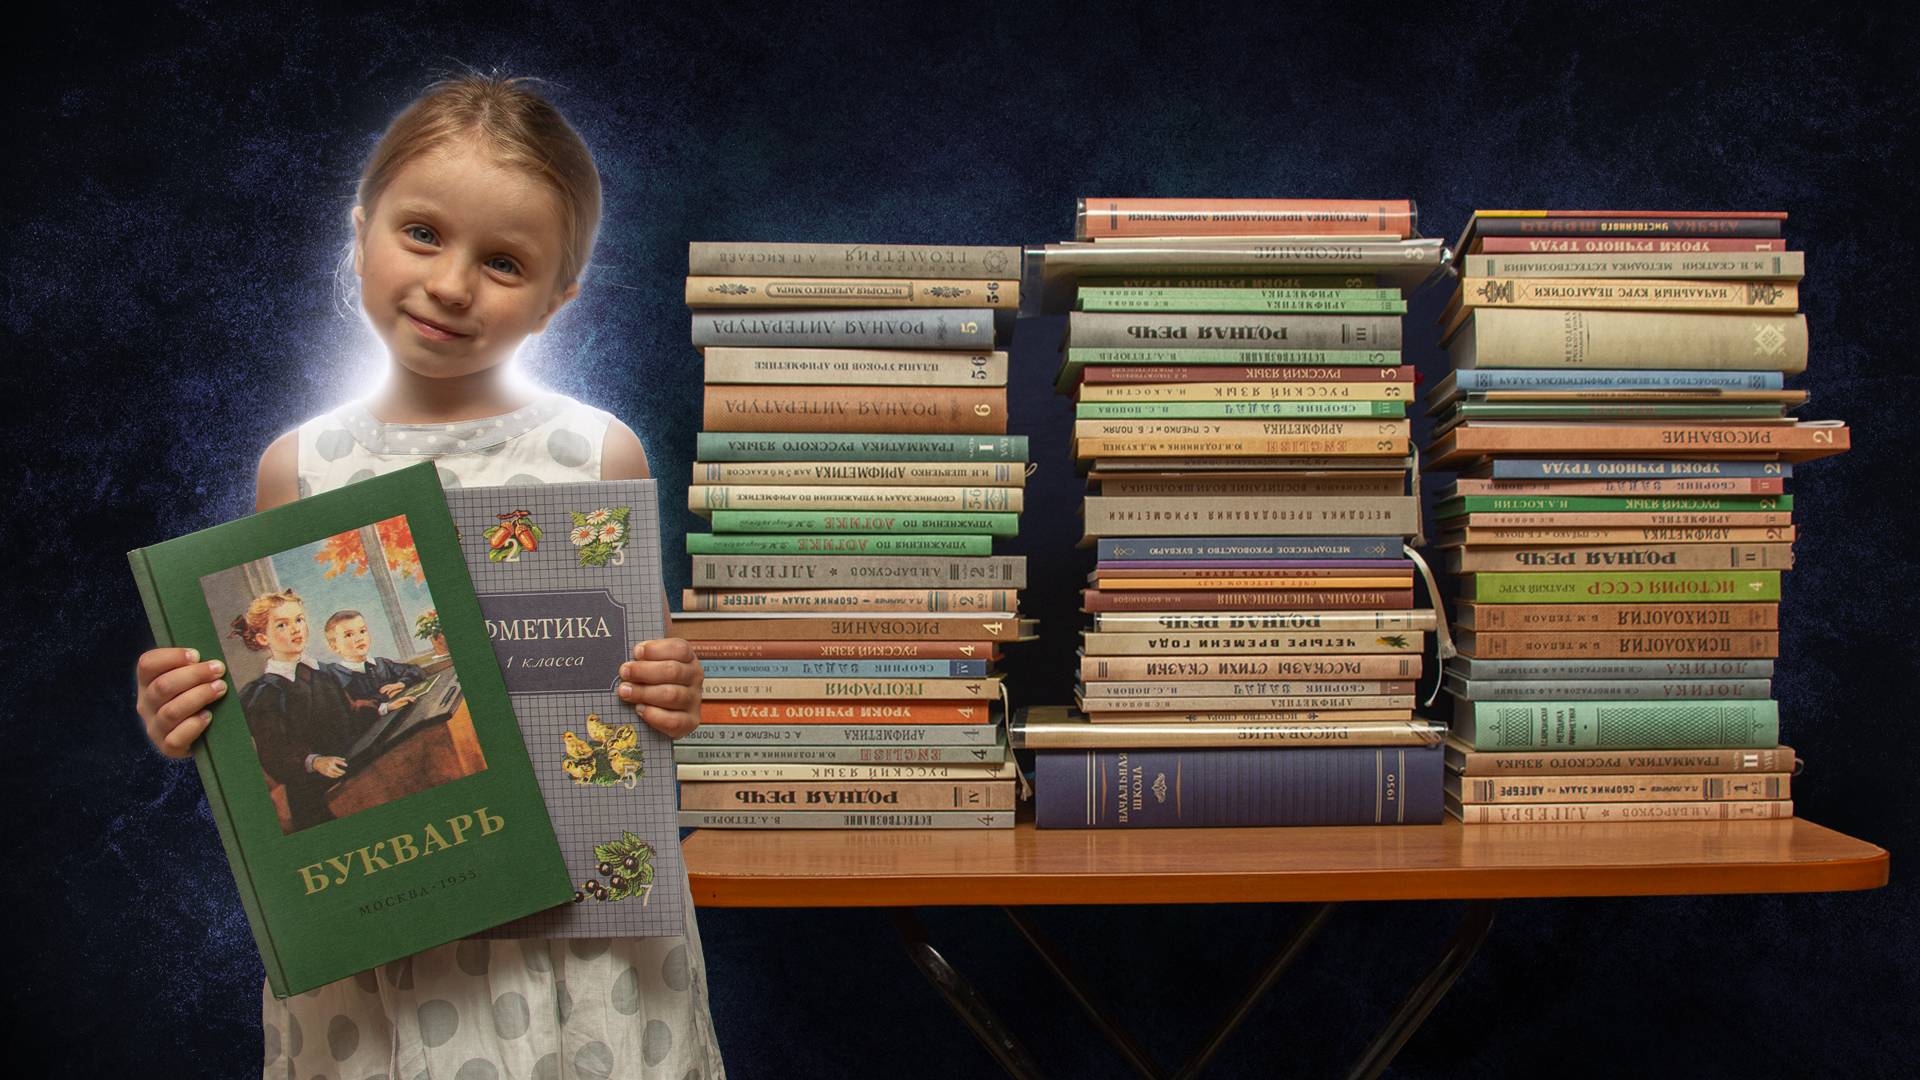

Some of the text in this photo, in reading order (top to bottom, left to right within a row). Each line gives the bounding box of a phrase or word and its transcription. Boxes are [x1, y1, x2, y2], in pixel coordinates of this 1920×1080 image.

[1601, 222, 1669, 232] УМСТВЕННОГО
[1530, 240, 1710, 253] УРОКИ РУЧНОГО ТРУДА
[845, 247, 966, 263] ГЕОМЕТРИЯ
[1254, 246, 1363, 260] РИСОВАНИЕ
[1504, 262, 1735, 272] СКАТКИН МЕТОДИКА ЕСТЕСТВОЗНАНИЯ
[776, 286, 902, 295] ИСТОРИЯ ДРЕВНЕГО МИРА
[1261, 290, 1340, 298] АРИФМЕТИКА
[1535, 287, 1727, 299] НАЧАЛЬНЫЙ КУРС ПЕДАГОГИКИ
[1266, 301, 1345, 309] АРИФМЕТИКА
[712, 319, 924, 335] РОДНАЯ ЛИТЕРАТУРА
[960, 321, 978, 333] 5
[1127, 325, 1288, 340] РОДНАЯ РЕЧЬ
[1239, 352, 1325, 363] ЕСТЕСТВОЗНАНИЕ
[754, 361, 939, 371] ПЛАНЫ УРОКОВ ПО АРИФМЕТИКЕ
[1246, 369, 1341, 380] РУССКИЙ ЯЗЫК
[1214, 388, 1349, 399] РУССКИЙ ЯЗЫК
[724, 400, 937, 417] РОДНАЯ ЛИТЕРАТУРА
[1296, 405, 1356, 413] СБОРНИК
[1263, 424, 1343, 435] АРИФМЕТИКА
[1662, 430, 1771, 444] РИСОВАНИЕ
[1813, 431, 1833, 443] 2
[728, 440, 776, 452] ЯЗЫКА
[783, 441, 854, 452] РУССКОГО
[862, 440, 954, 452] ГРАММАТИКА
[1266, 441, 1347, 452] ENGLISH
[815, 465, 906, 480] АРИФМЕТИКА
[910, 469, 967, 477] ШЕВЧЕНКО
[1542, 463, 1720, 474] УРОКИ РУЧНОГО ТРУДА
[1677, 482, 1736, 490] СБОРНИК
[736, 493, 797, 502] АРИФМЕТИКЕ
[885, 494, 912, 502] ЗАДАЧ
[1626, 499, 1720, 511] РУССКИЙ ЯЗЫК
[1108, 510, 1391, 521] МЕТОДИКА ПРЕПОДАВАНИЯ АРИФМЕТИКИ
[1651, 515, 1730, 524] АРИФМЕТИКА
[824, 517, 896, 530] ЛОГИКЕ
[922, 519, 993, 528] УПРАЖНЕНИЯ
[1643, 529, 1730, 541] АРИФМЕТИКА
[504, 538, 520, 562] 2
[797, 538, 869, 552] ЛОГИКЕ
[895, 540, 966, 549] УПРАЖНЕНИЯ
[1149, 545, 1350, 555] МЕТОДИЧЕСКОЕ РУКОВОДСТВО БУКВАРЮ
[611, 542, 625, 566] 3
[1516, 550, 1676, 565] РОДНАЯ РЕЧЬ
[726, 564, 817, 579] АЛГЕБРА
[1500, 580, 1735, 595] ИСТОРИЯ СССР КРАТКИЙ КУРС
[723, 596, 858, 606] СБОРНИК АЛГЕБРЕ
[1217, 593, 1385, 605] МЕТОДИКА ЧИСТОПИСАНИЯ
[1158, 613, 1322, 630] РОДНАЯ РЕЧЬ
[1618, 610, 1729, 625] ПСИХОЛОГИЯ
[831, 621, 939, 634] РИСОВАНИЕ
[983, 622, 1003, 635] 4
[1147, 637, 1355, 649] ЧЕТЫРЕ ВРЕМЕНИ ГОДА
[1620, 638, 1731, 653] ПСИХОЛОГИЯ
[820, 646, 918, 656] РУССКИЙ ЯЗЫК
[958, 645, 975, 656] 4
[522, 656, 585, 669] класса
[874, 664, 933, 673] СБОРНИК
[1147, 661, 1361, 675] РАССКАЗЫ СТИХИ СКАЗКИ
[1666, 663, 1748, 675] ЛОГИКА
[825, 682, 923, 695] ГЕОГРАФИЯ
[1306, 684, 1365, 693] СБОРНИК
[1663, 685, 1745, 697] ЛОГИКА
[1271, 699, 1352, 707] АРИФМЕТИКА
[730, 706, 911, 717] УРОКИ РУЧНОГО ТРУДА
[958, 706, 974, 717] 4
[1243, 713, 1297, 721] ИСКУССТВО
[844, 729, 925, 740] АРИФМЕТИКА
[1237, 725, 1349, 740] РИСОВАНИЕ
[859, 749, 941, 760] ENGLISH
[1496, 757, 1719, 770] ГРАММАТИКА РУССКОГО ЯЗЫКА
[624, 765, 637, 789] 5
[811, 768, 948, 779] РУССКИЙ ЯЗЫК
[1118, 753, 1129, 823] НАЧАЛЬНАЯ
[1132, 766, 1143, 810] ШКОЛА
[1500, 784, 1635, 796] СБОРНИК АЛГЕБРЕ
[735, 790, 898, 804] РОДНАЯ РЕЧЬ
[1500, 806, 1590, 821] АЛГЕБРА
[844, 815, 932, 826] ЕСТЕСТВОЗНАНИЕ
[298, 806, 505, 896] БУКВАРЬ
[640, 884, 653, 907] 7
[359, 887, 428, 917] МОСКВА
